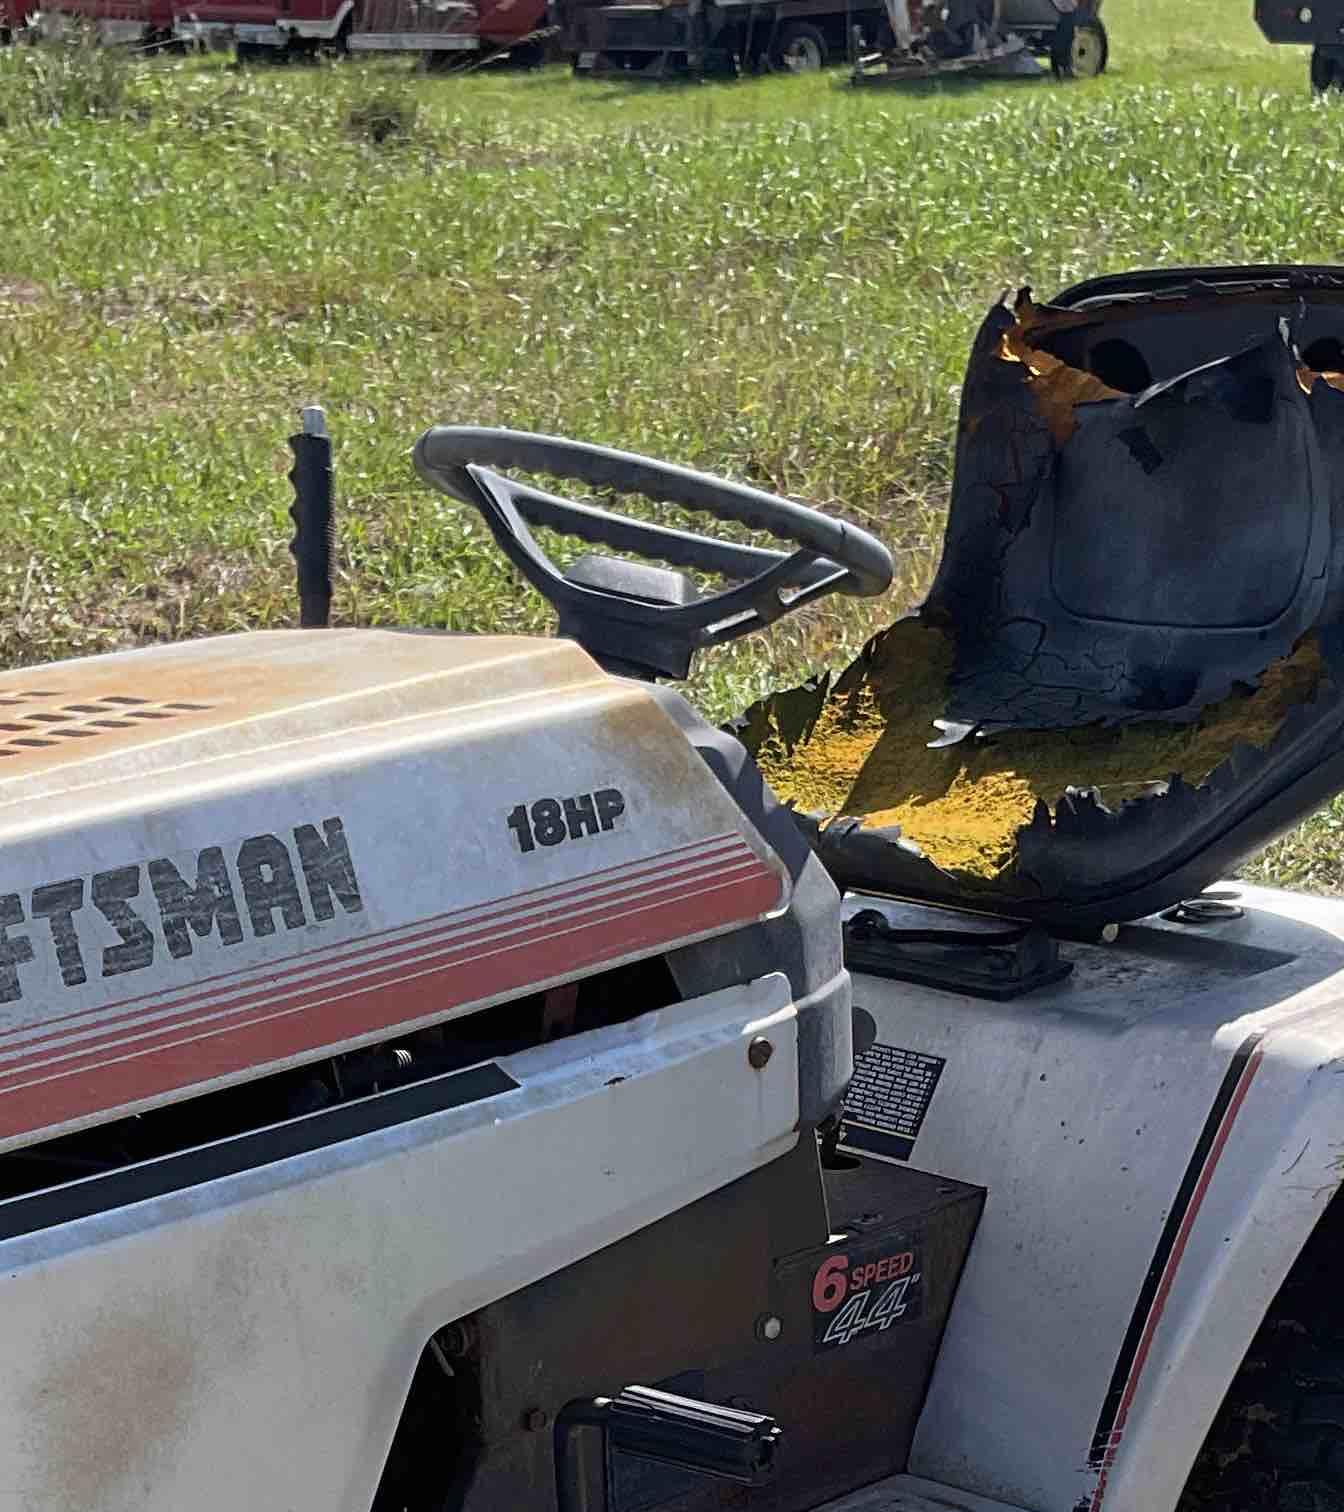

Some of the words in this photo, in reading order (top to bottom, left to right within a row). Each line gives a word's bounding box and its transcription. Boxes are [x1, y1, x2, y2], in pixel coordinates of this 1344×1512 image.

[507, 789, 625, 853] 18HP
[813, 1255, 849, 1312] 6
[850, 1252, 914, 1291] SPEED
